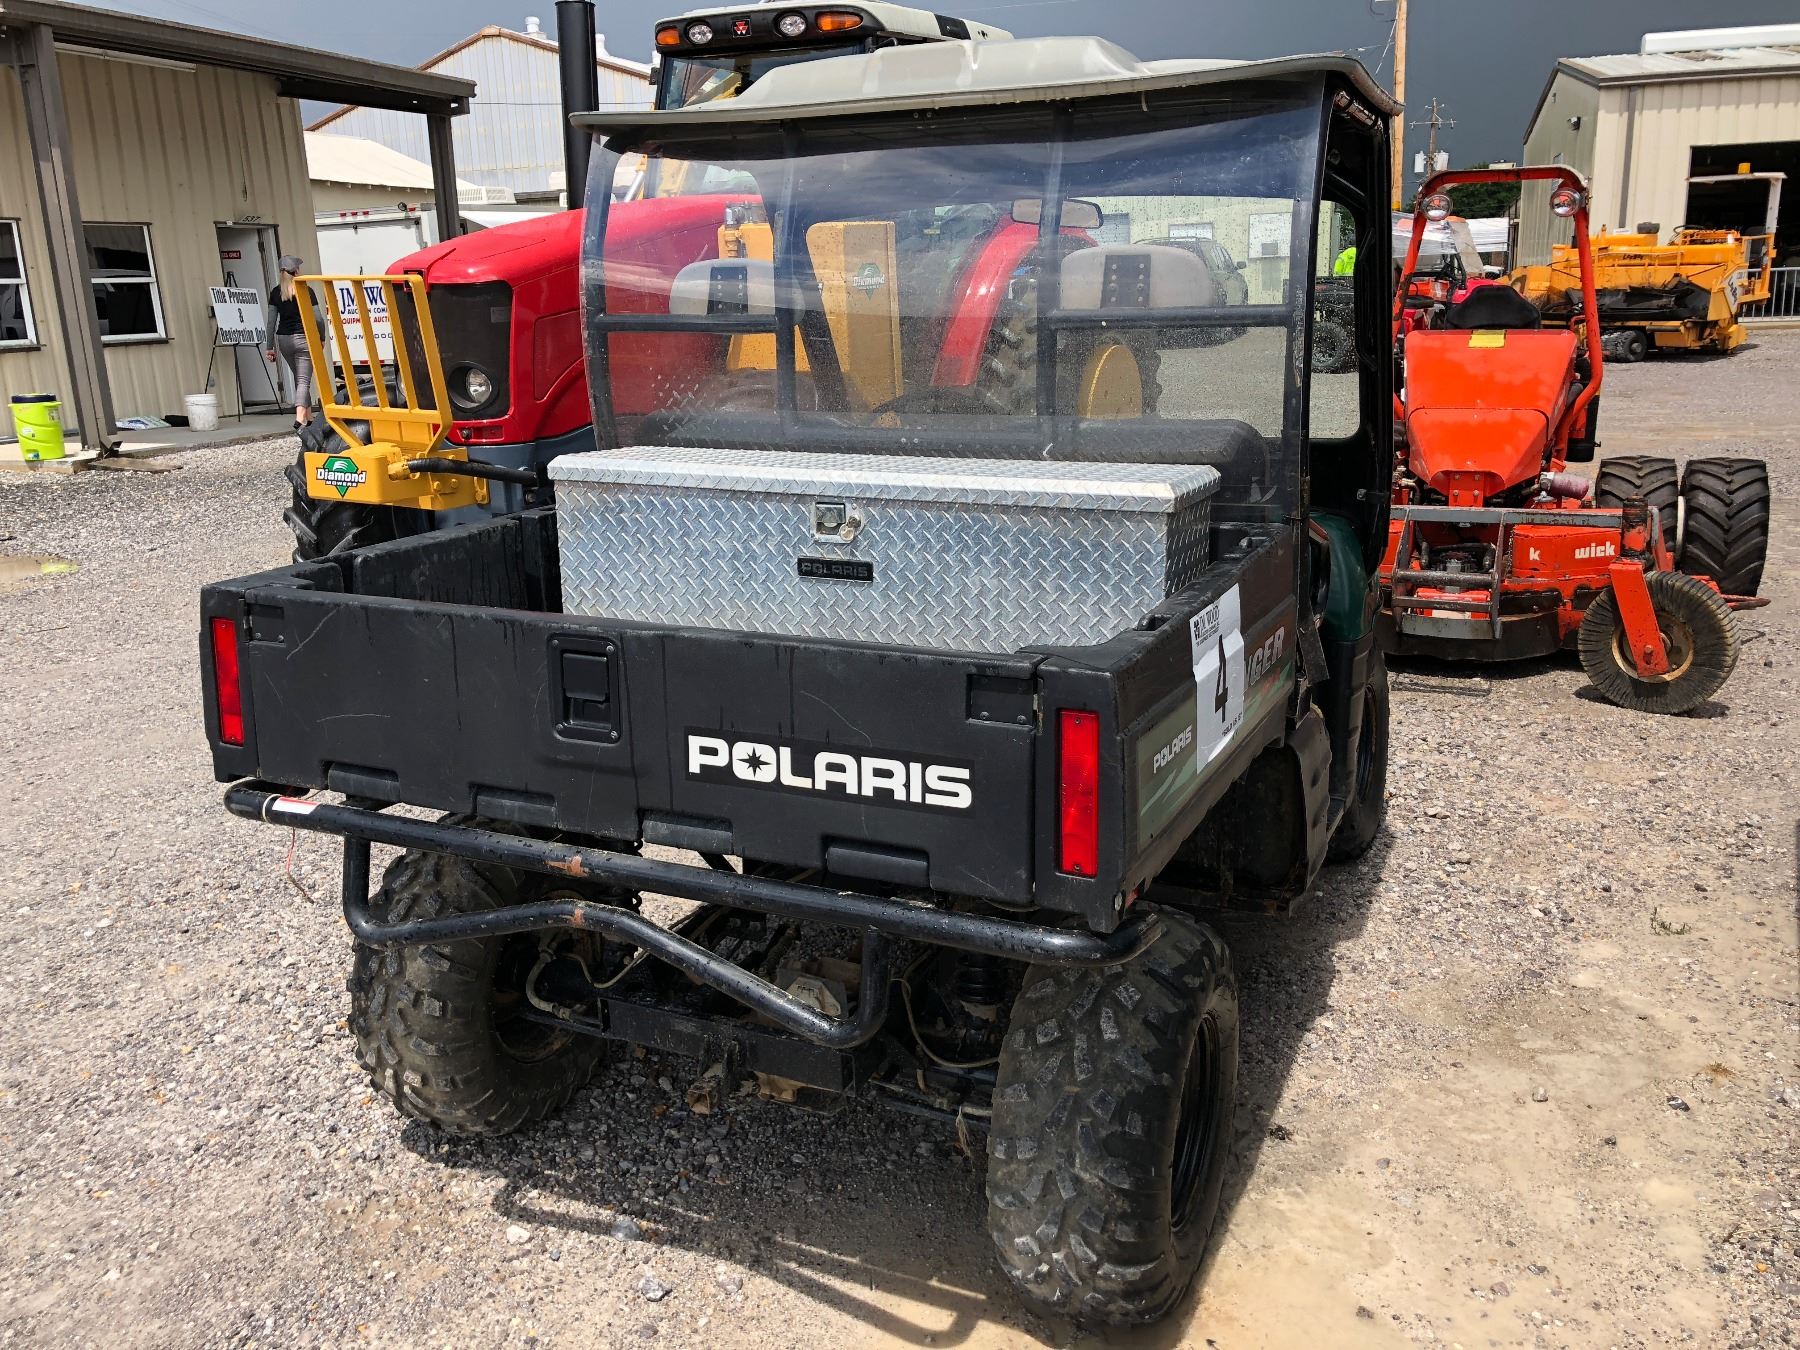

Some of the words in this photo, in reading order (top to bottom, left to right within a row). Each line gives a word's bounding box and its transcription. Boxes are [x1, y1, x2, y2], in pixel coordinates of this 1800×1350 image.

[211, 288, 227, 303] Title
[227, 289, 258, 304] Processing
[237, 308, 244, 323] &
[220, 327, 254, 343] Registration
[316, 468, 366, 483] Diamond
[1574, 541, 1616, 559] wick
[801, 562, 868, 577] POLARIS
[1214, 634, 1229, 724] 4
[1153, 724, 1193, 774] POLARIS
[687, 734, 973, 809] POLARIS
